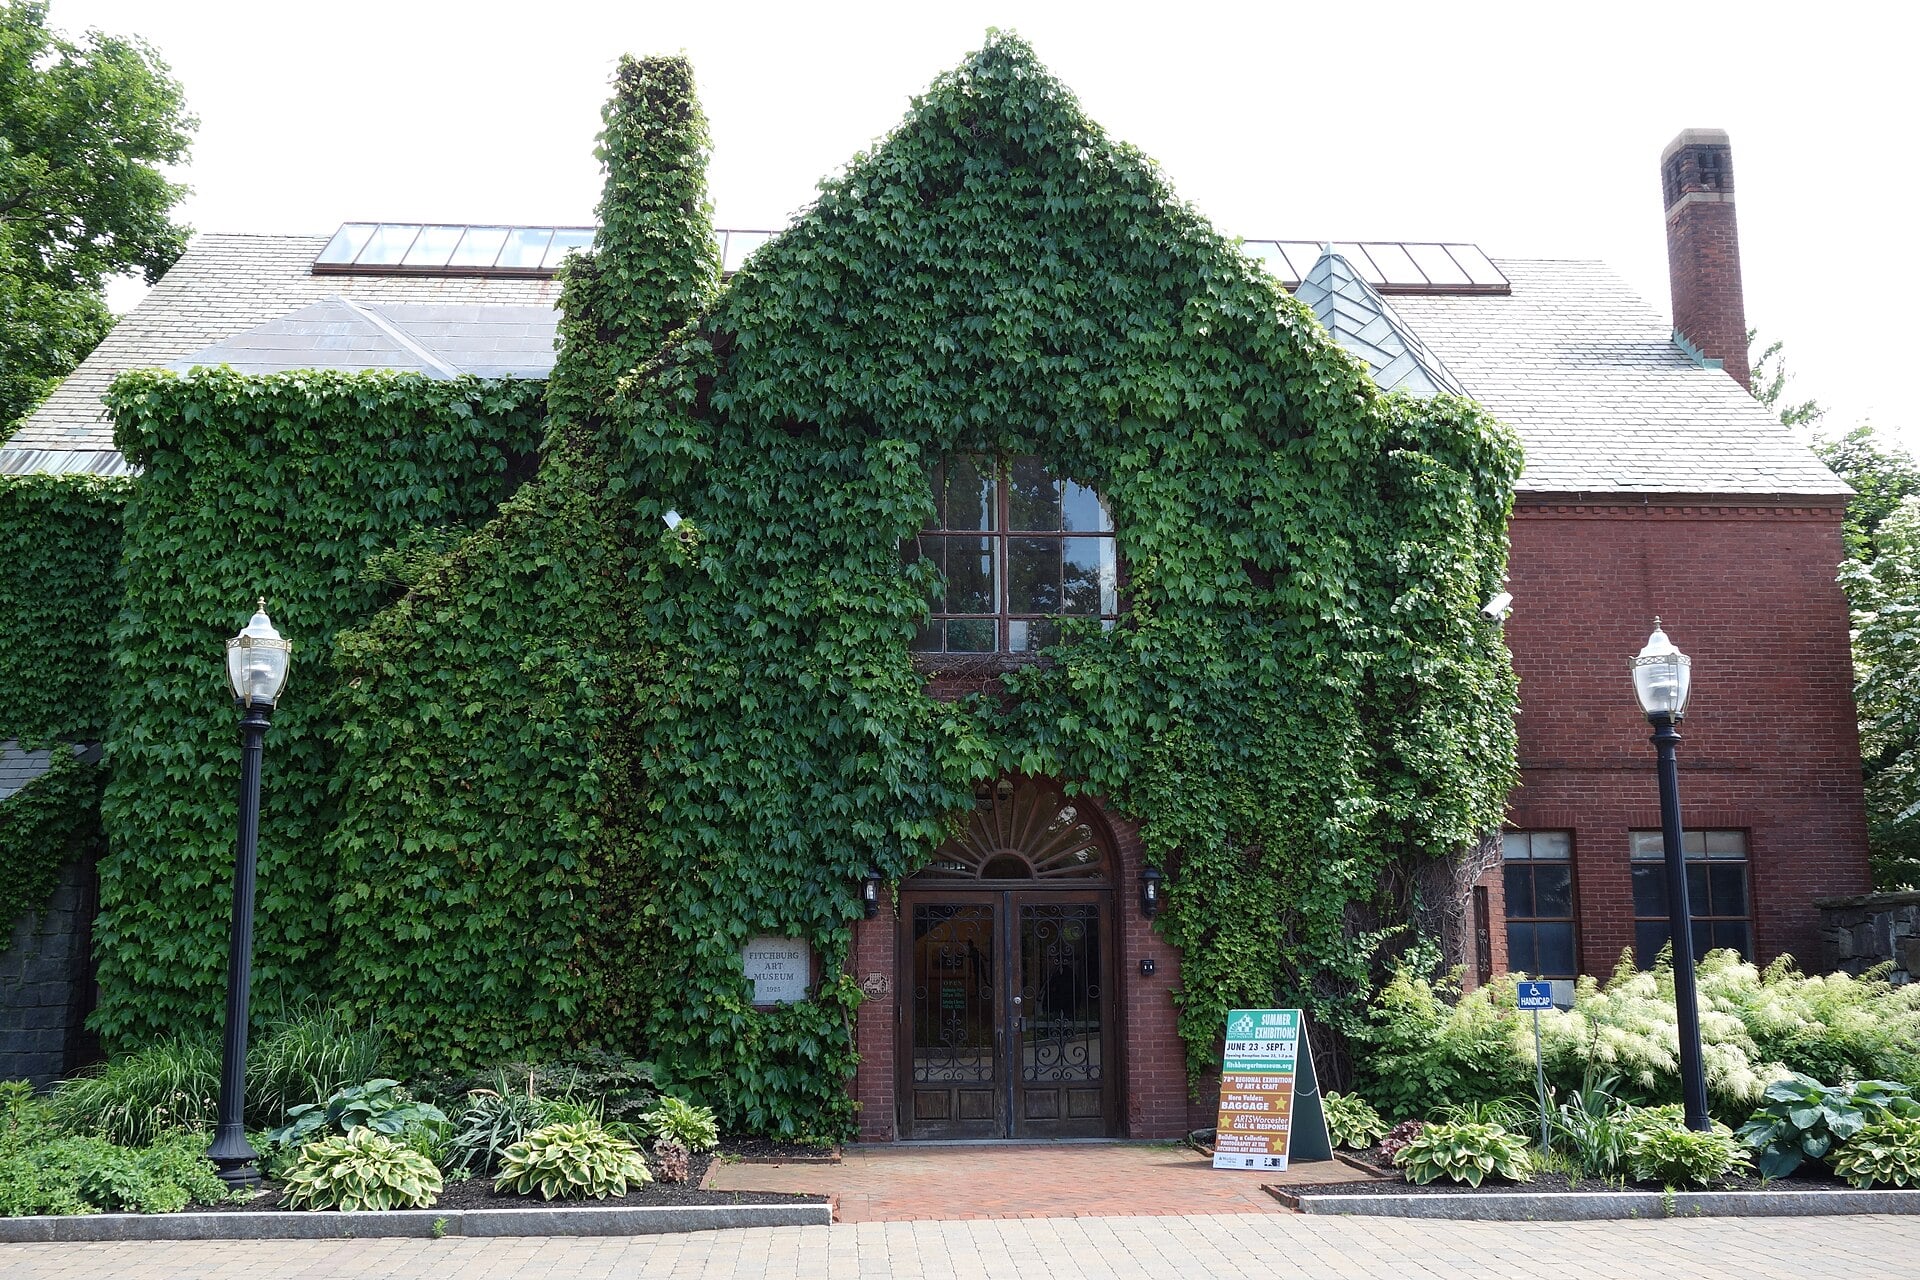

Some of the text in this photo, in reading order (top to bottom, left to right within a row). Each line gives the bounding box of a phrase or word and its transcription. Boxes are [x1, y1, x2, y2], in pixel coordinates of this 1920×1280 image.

[749, 952, 799, 960] FITCHBURG
[1520, 997, 1550, 1006] HANDICAP
[1261, 1013, 1291, 1026] SUMMER
[1255, 1027, 1296, 1039] EXHIBITIONS
[1226, 1042, 1246, 1051] JUNE
[1248, 1043, 1259, 1051] 23
[1265, 1043, 1286, 1051] SEPT.
[1289, 1043, 1293, 1051] 1
[1221, 1101, 1270, 1111] BAGGAGE
[1234, 1114, 1289, 1124] ARTSWorcester
[1217, 1133, 1239, 1141] Building
